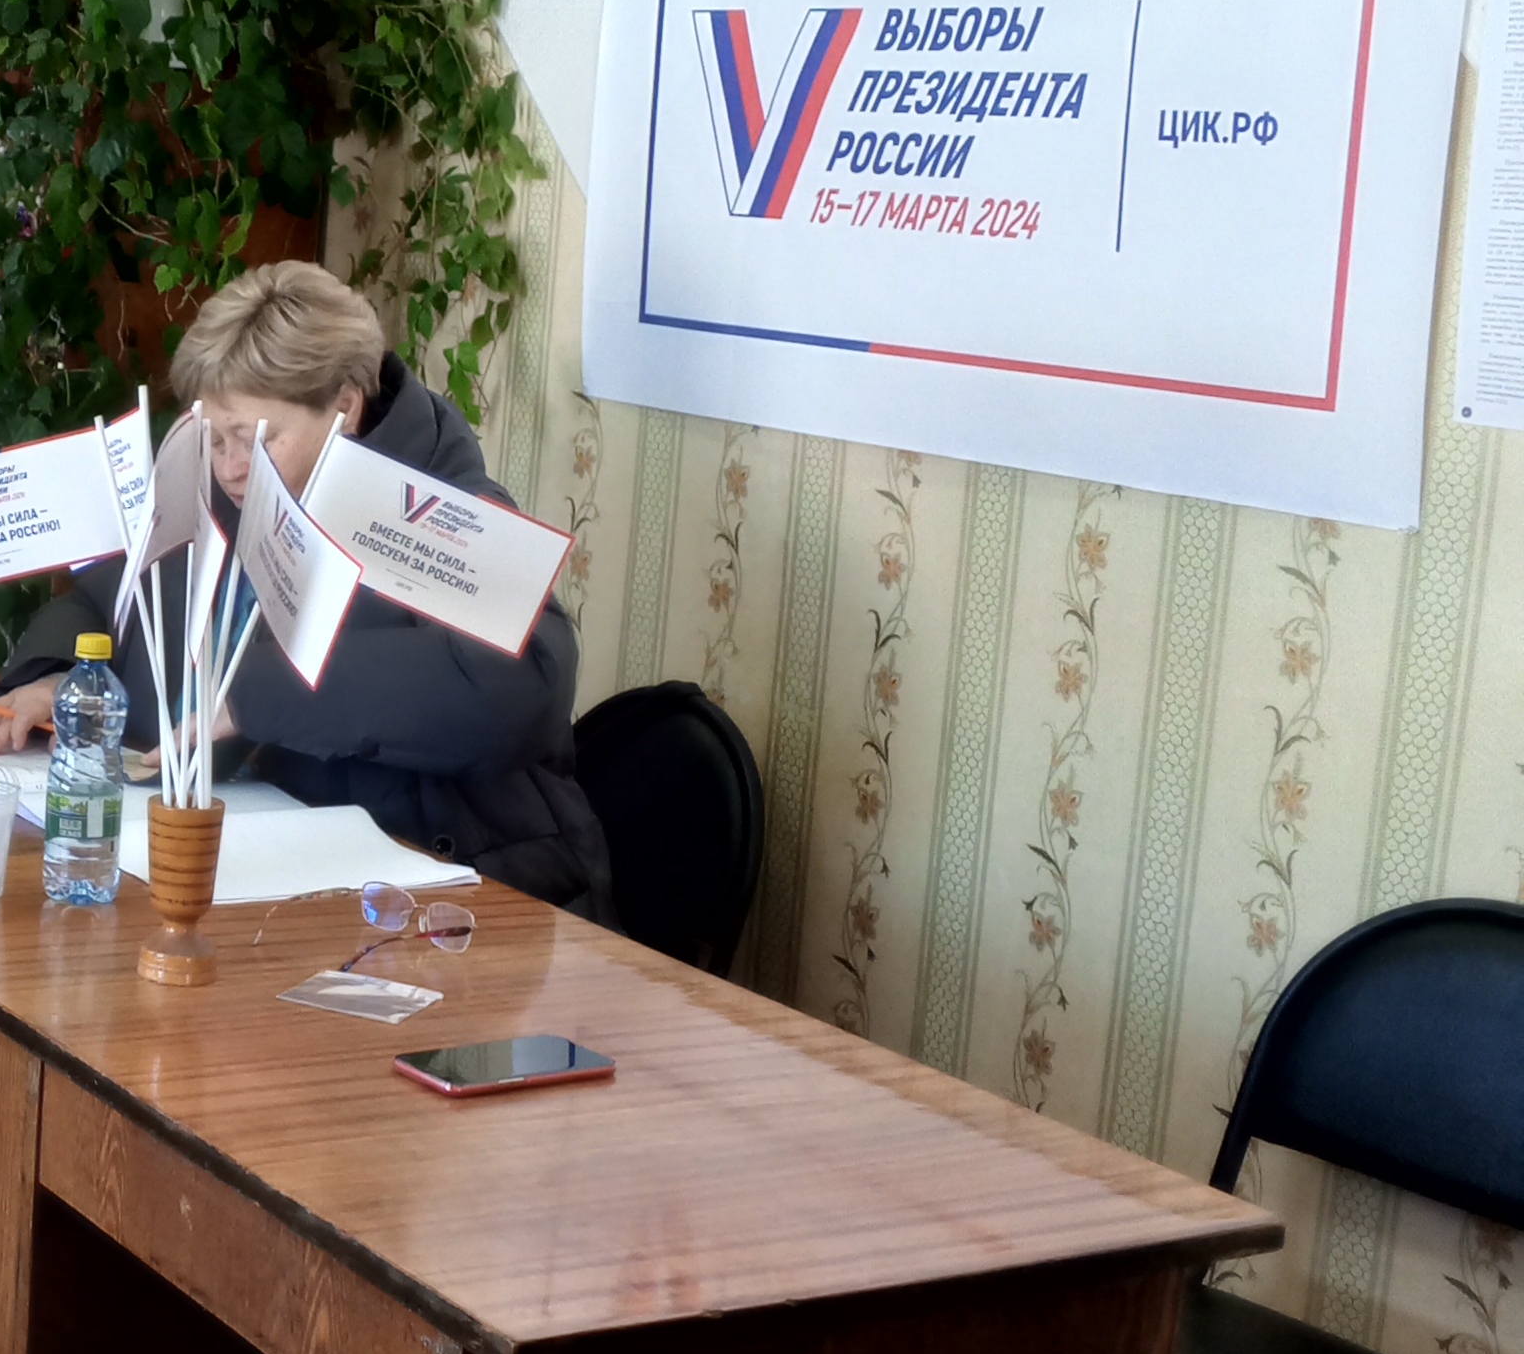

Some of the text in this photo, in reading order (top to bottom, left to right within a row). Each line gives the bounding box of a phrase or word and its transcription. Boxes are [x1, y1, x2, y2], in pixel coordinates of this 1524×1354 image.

[874, 7, 1045, 52] ВЫБОРЫ
[847, 70, 1089, 123] ПРЕЗИДЕНТА
[1158, 109, 1279, 149] ЦИК.РФ
[826, 130, 976, 179] РОССИИ
[878, 192, 971, 234] МАРТА
[970, 197, 1042, 240] 2024
[7, 508, 39, 525] СИЛА
[10, 519, 61, 541] РОССИЮ!
[352, 531, 479, 596] ГОЛОСУЕМ ЗА РОССИЮ!
[369, 521, 413, 549] ВМЕСТЕ
[413, 540, 435, 559] МЫ
[436, 551, 466, 574] СИЛА
